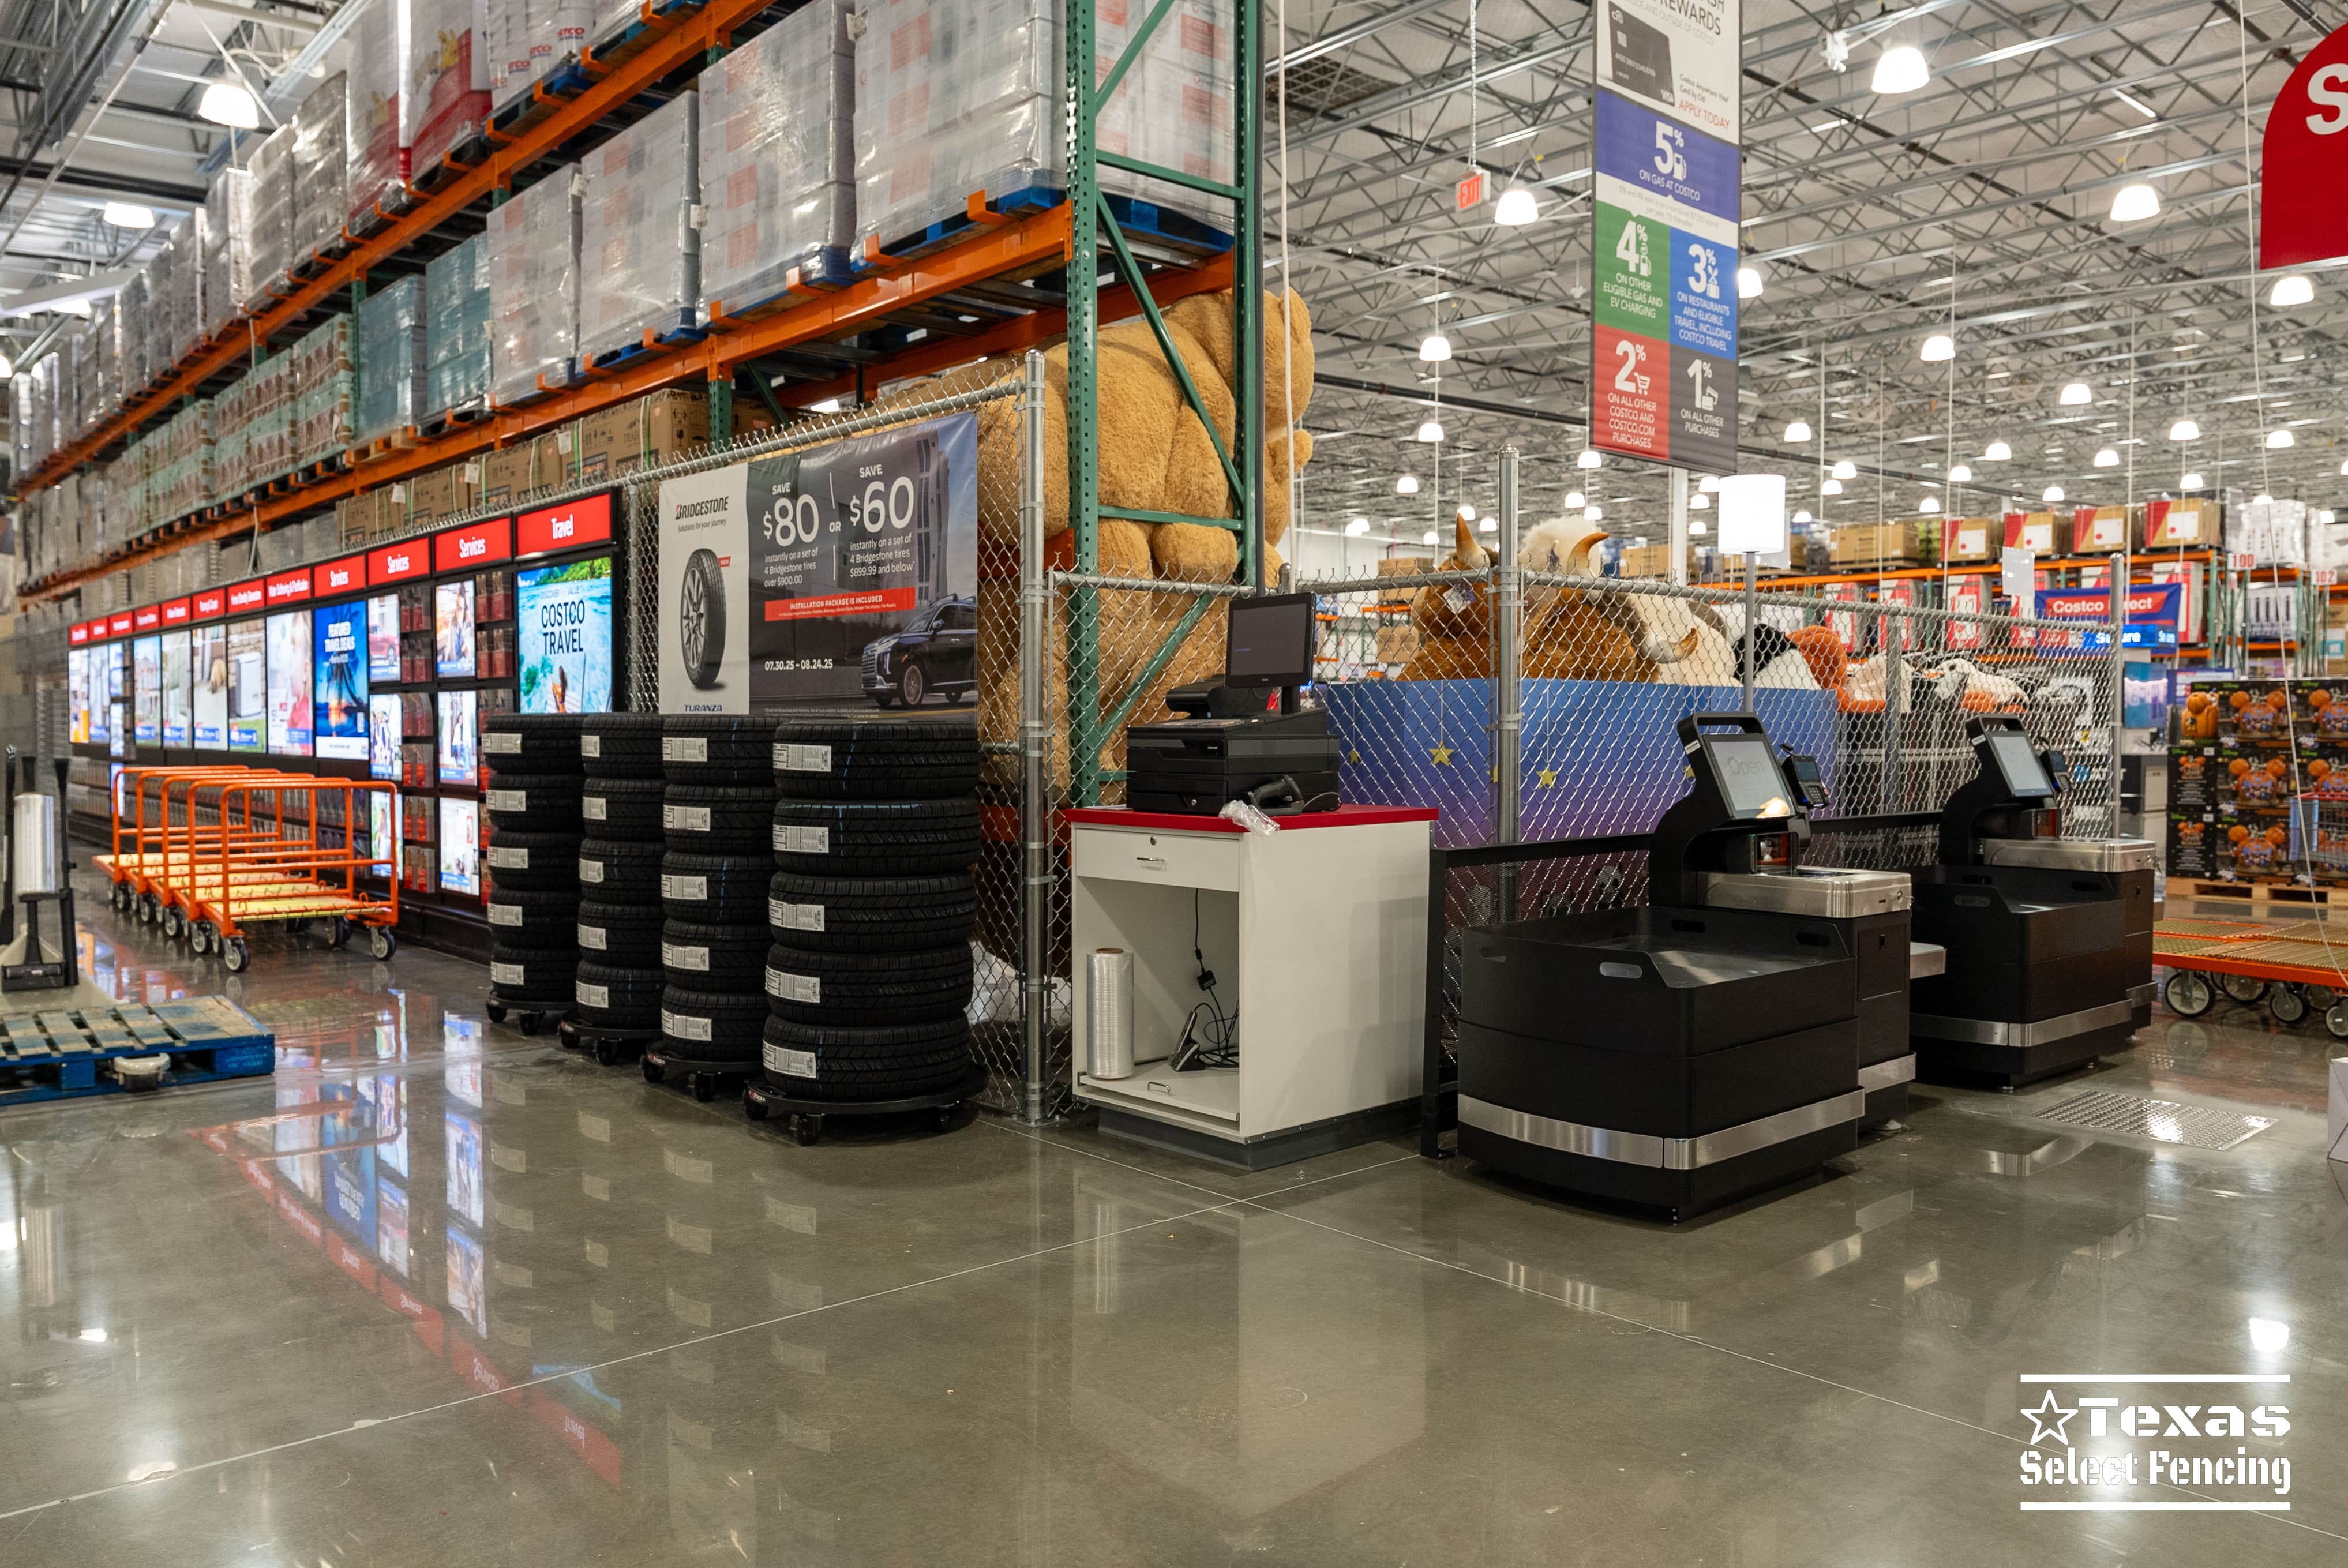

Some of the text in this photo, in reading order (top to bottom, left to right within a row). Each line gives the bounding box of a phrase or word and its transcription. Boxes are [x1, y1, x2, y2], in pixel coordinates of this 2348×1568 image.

[1679, 99, 1730, 130] APPLY TODAY
[1460, 175, 1481, 209] EXIT
[1639, 169, 1701, 201] ON GAS AT COSTCO
[1616, 273, 1652, 292] ON OTHER
[1603, 282, 1663, 307] ELIGIBLE GAS AND
[1677, 291, 1730, 316] ON RESTAURANTS
[1610, 297, 1656, 318] EV CHARGING
[1683, 306, 1724, 326] AND ELIGIBLE
[1679, 329, 1727, 351] COSTCO TRAVEL
[1698, 322, 1732, 340] INCLUDING
[1608, 392, 1657, 412] ON ALL OTHER
[1610, 406, 1655, 423] COSTCO AND
[1680, 408, 1724, 427] ON ALL OTHER
[1608, 418, 1656, 437] COSTCO.COM
[1685, 421, 1720, 438] PURCHASES
[1612, 432, 1652, 449] PURCHASES
[859, 464, 883, 478] SAVE
[772, 482, 791, 495] SAVE
[676, 496, 729, 520] BRIDGESTONE
[850, 476, 914, 533] $60
[551, 514, 574, 540] Travel
[678, 523, 695, 532] Solutions
[763, 494, 819, 546] $80
[829, 521, 841, 532] OR
[459, 535, 486, 558] Services
[850, 539, 877, 551] instantly
[878, 539, 887, 547] on
[893, 535, 903, 545] set
[905, 532, 912, 543] of
[387, 554, 410, 574] Services
[764, 552, 788, 563] instantly
[789, 552, 798, 560] on
[801, 548, 811, 558] set
[811, 546, 818, 556] of
[850, 549, 910, 564] 4 Bridgestone tires
[2232, 554, 2255, 567] 100
[330, 569, 349, 587] Services
[764, 561, 816, 576] 4 Bridgestone tires
[850, 565, 877, 578] $899.99
[877, 564, 890, 573] and
[2315, 571, 2335, 583] 102
[764, 575, 803, 587] over $900.00
[789, 595, 883, 610] INSTALLATION PACKAGE IS INCLUDED
[2053, 600, 2105, 613] Costco
[541, 599, 585, 628] COSTCO
[543, 628, 583, 655] TRAVEL
[764, 661, 794, 671] 07.30.25
[800, 659, 834, 670] 08.24.25
[683, 704, 723, 713] TURANZA
[1727, 756, 1765, 779] Open
